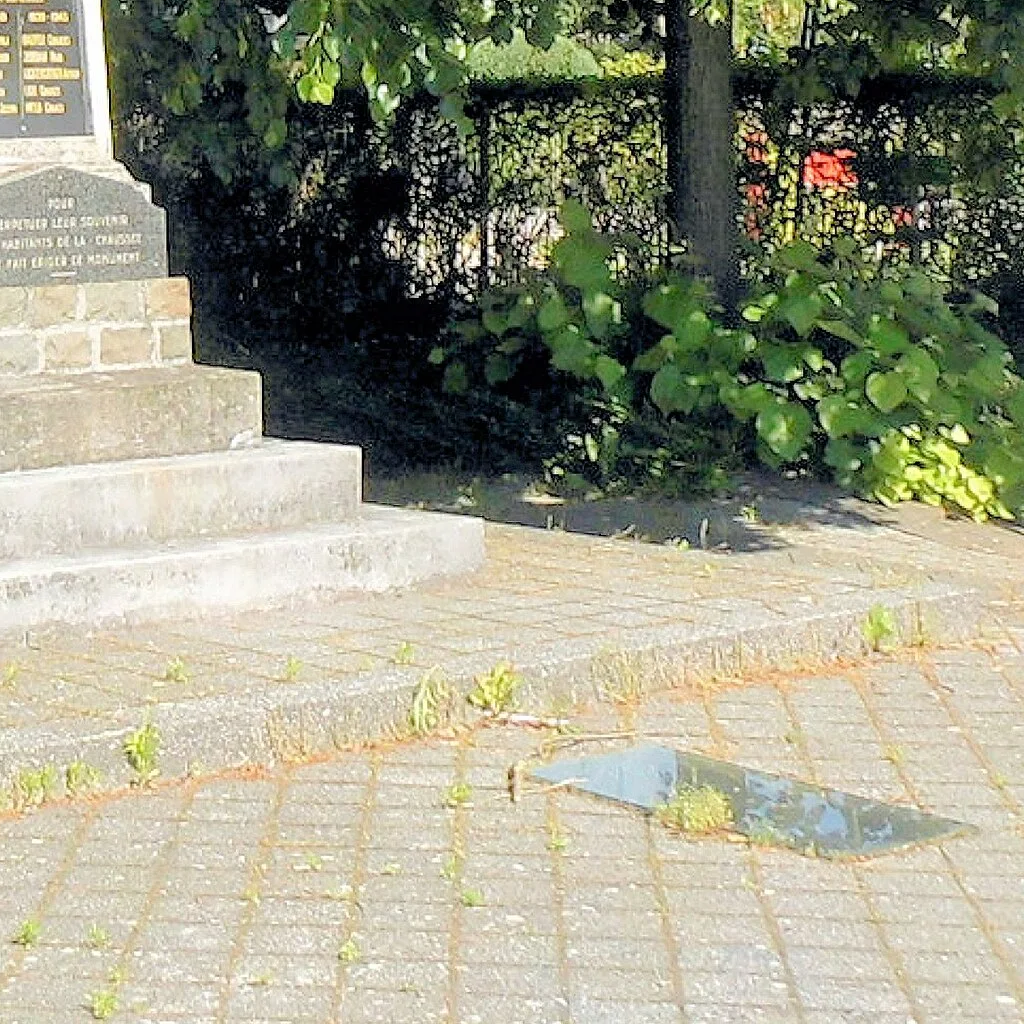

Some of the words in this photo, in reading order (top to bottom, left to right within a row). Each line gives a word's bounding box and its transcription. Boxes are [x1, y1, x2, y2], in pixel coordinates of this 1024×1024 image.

[48, 197, 75, 210] POUR
[80, 214, 129, 228] SOUVENIR
[1, 236, 53, 250] HABITANTS
[74, 235, 87, 248] LA
[87, 252, 140, 266] MONUMENT
